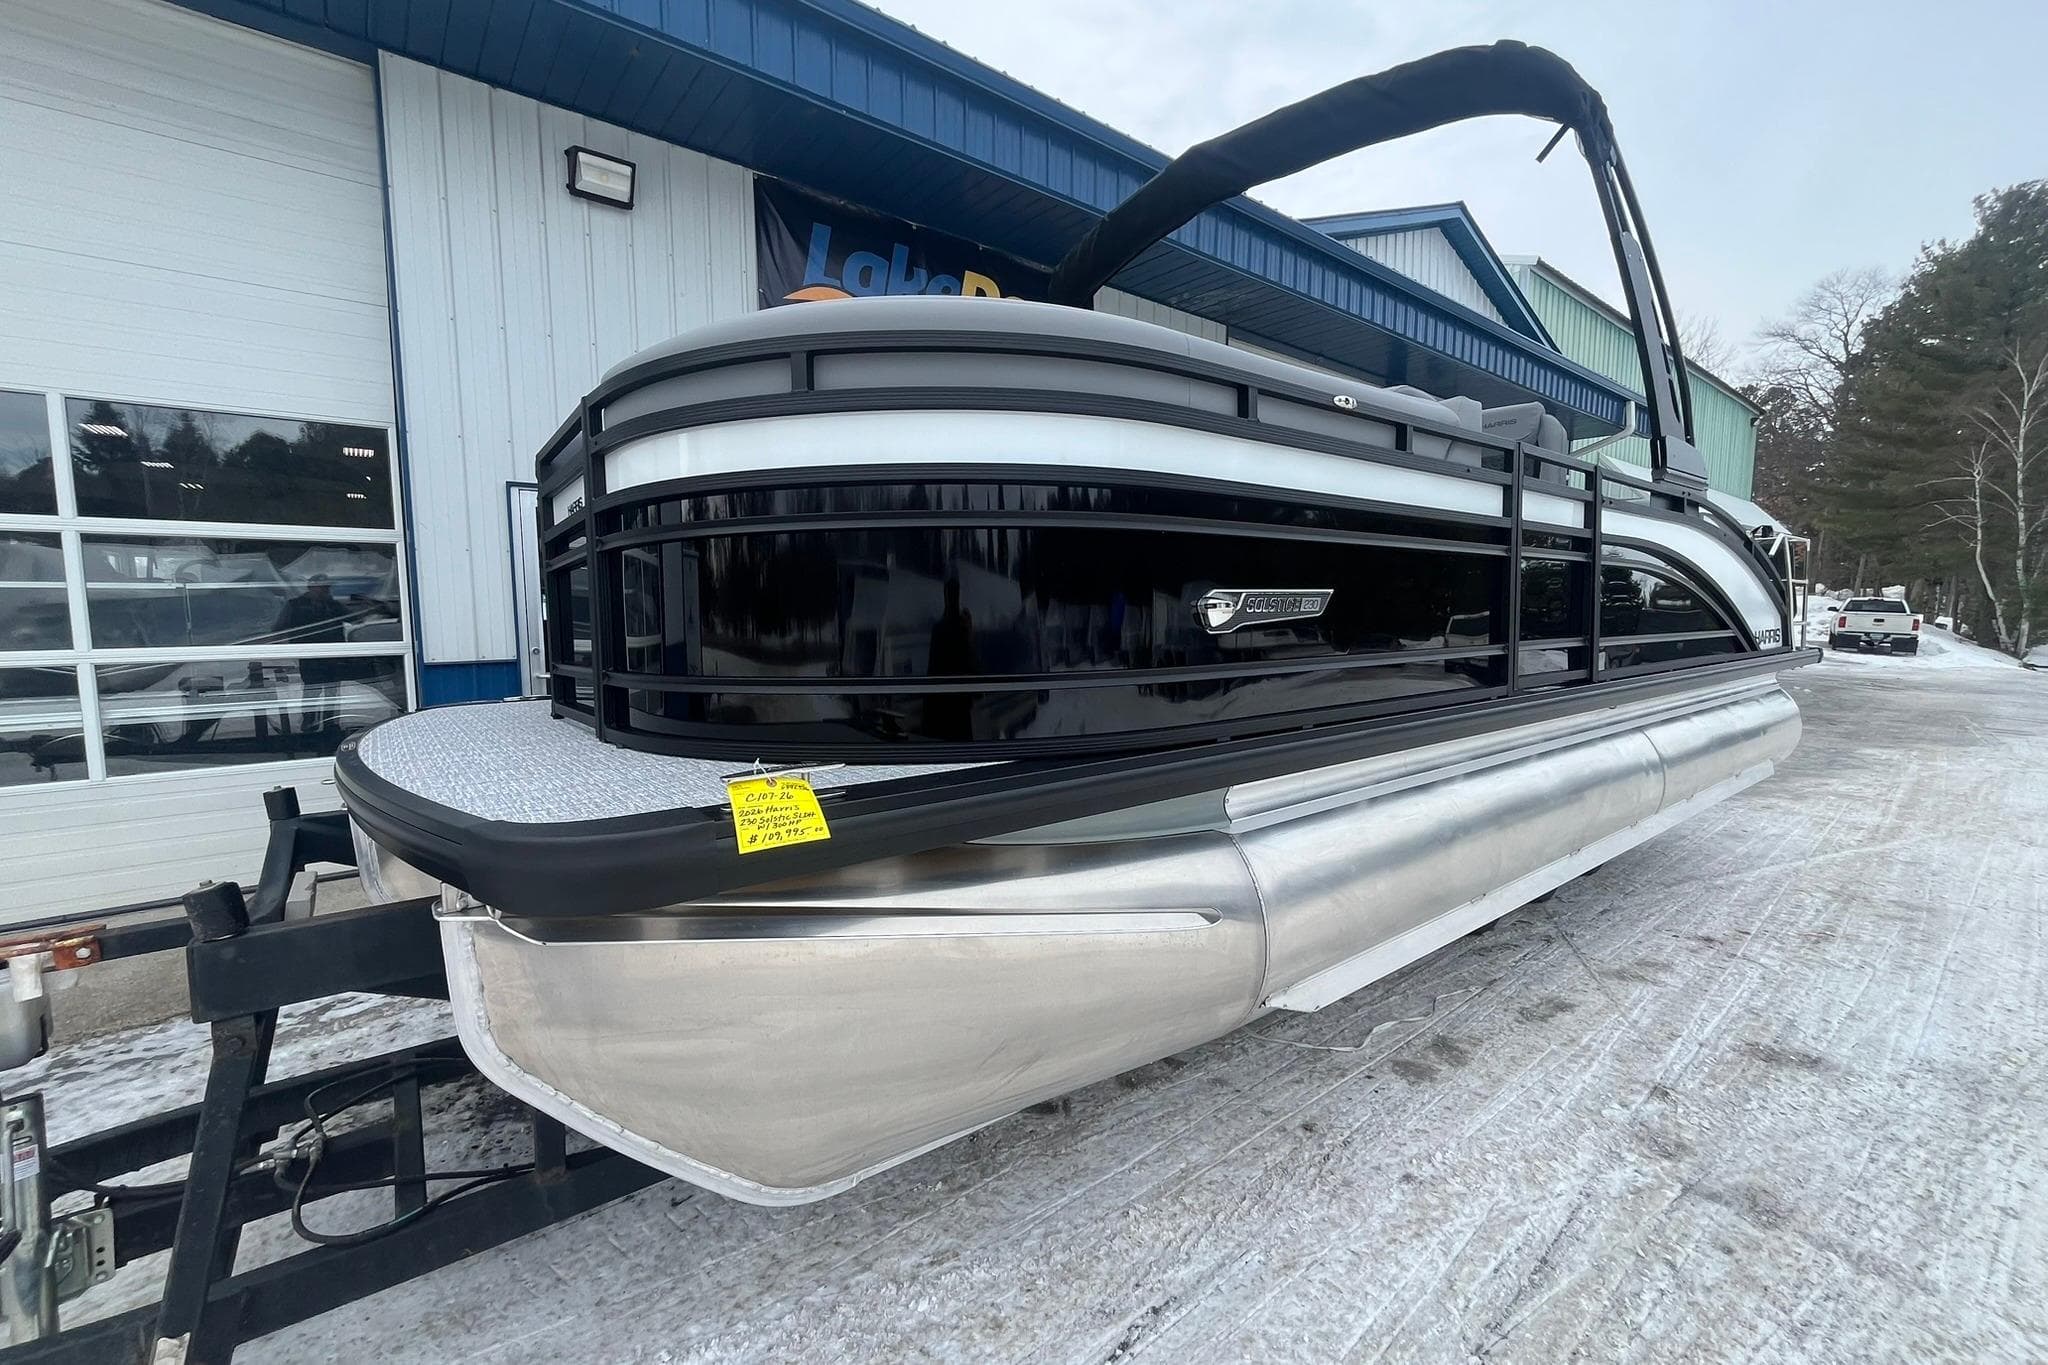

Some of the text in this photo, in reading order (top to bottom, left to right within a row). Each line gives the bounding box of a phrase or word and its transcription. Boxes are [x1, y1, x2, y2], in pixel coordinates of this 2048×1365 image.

[1246, 597, 1320, 613] SOLSTICE 230
[738, 804, 800, 818] 2026 Harris
[740, 818, 758, 827] 230
